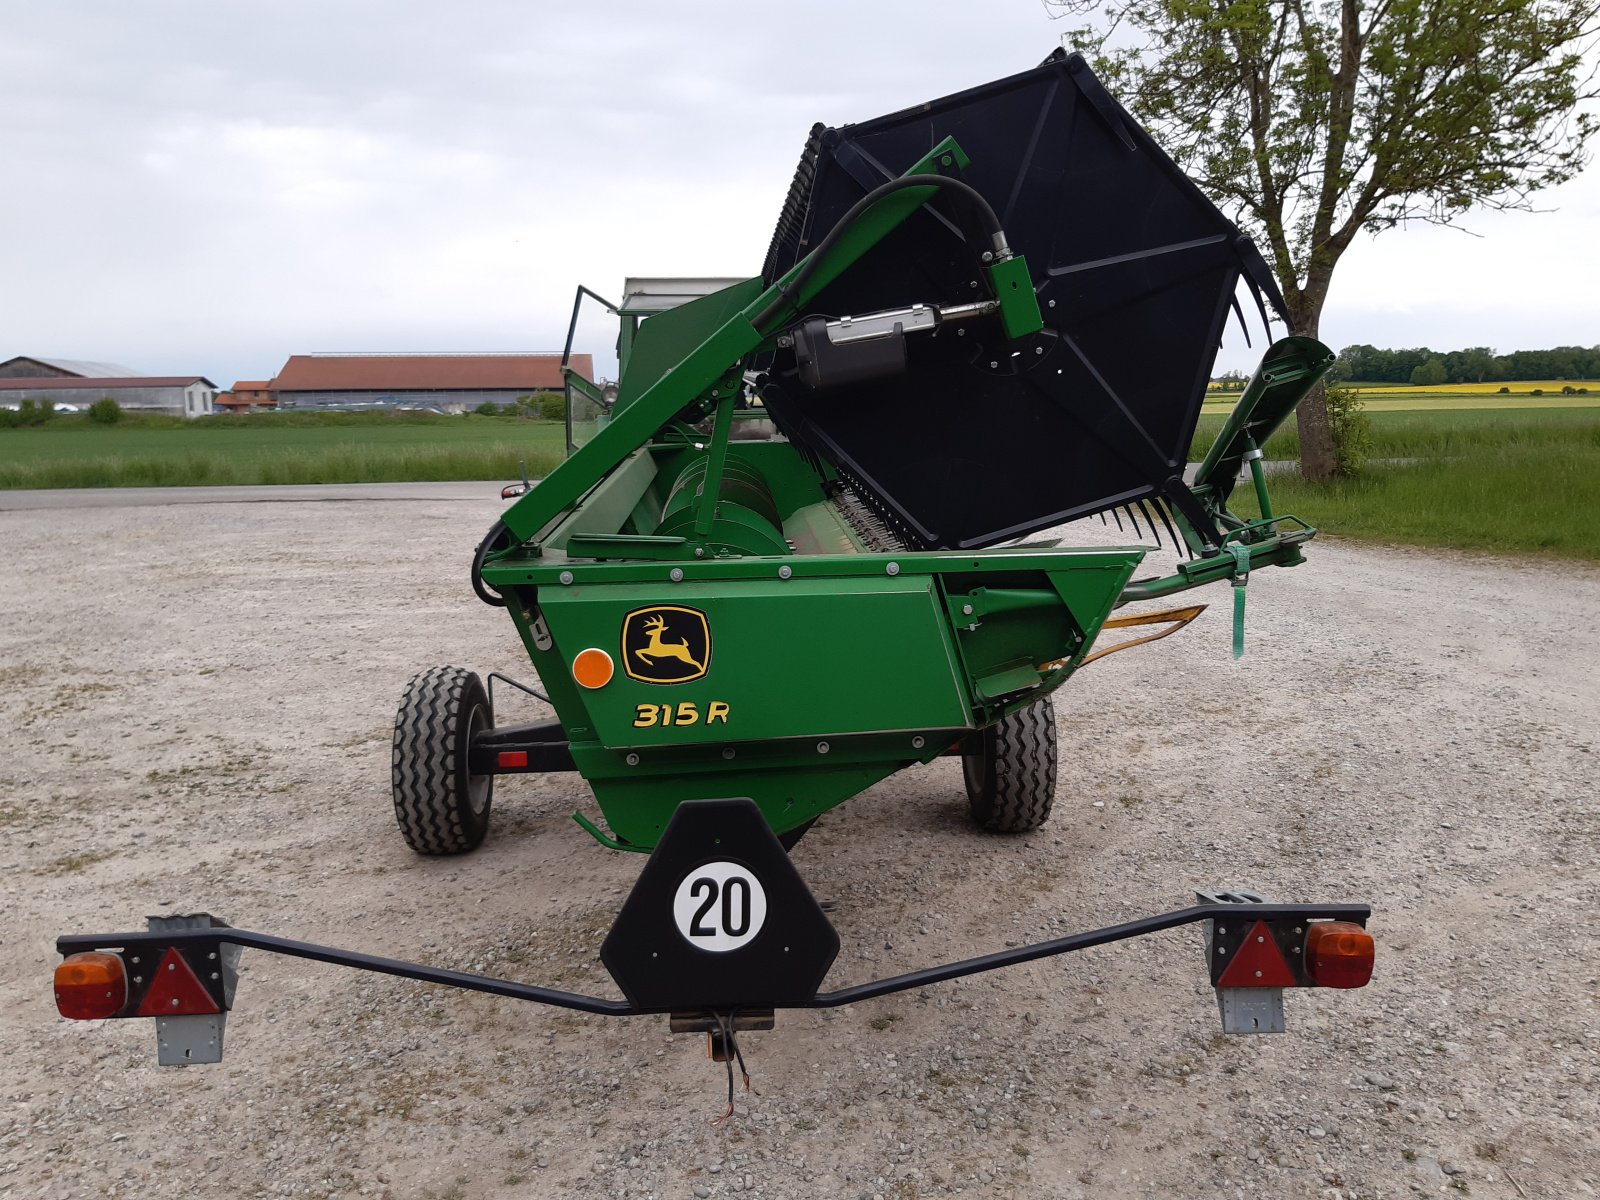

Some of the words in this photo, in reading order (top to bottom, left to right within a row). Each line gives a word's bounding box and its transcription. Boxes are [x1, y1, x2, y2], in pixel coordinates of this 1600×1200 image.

[633, 702, 699, 728] 315
[705, 701, 730, 725] R
[689, 876, 751, 937] 20
